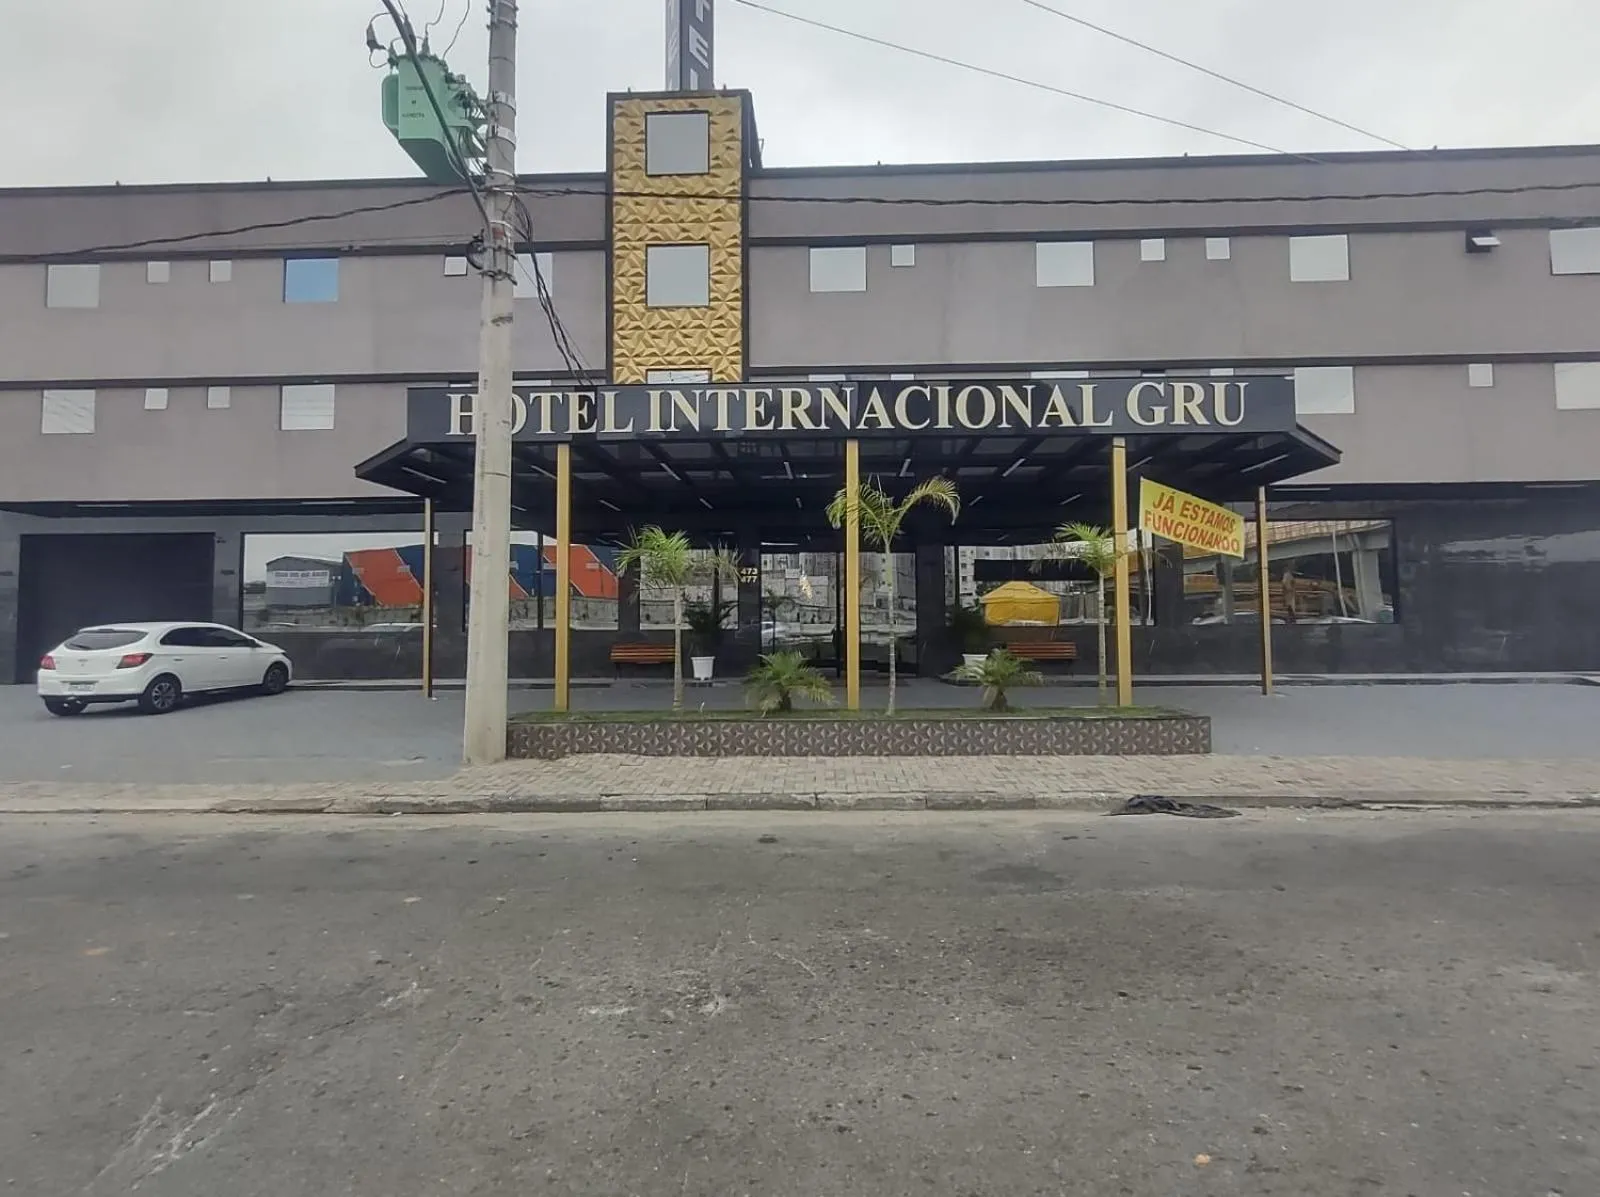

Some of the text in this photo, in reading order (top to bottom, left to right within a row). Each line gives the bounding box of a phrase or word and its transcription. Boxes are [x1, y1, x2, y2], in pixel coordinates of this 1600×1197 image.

[645, 384, 1113, 432] INTERNACIONAL
[1125, 381, 1250, 427] GRU
[1144, 510, 1240, 553] FUNCIONANDO
[1153, 491, 1236, 534] JÁ ESTAMOS
